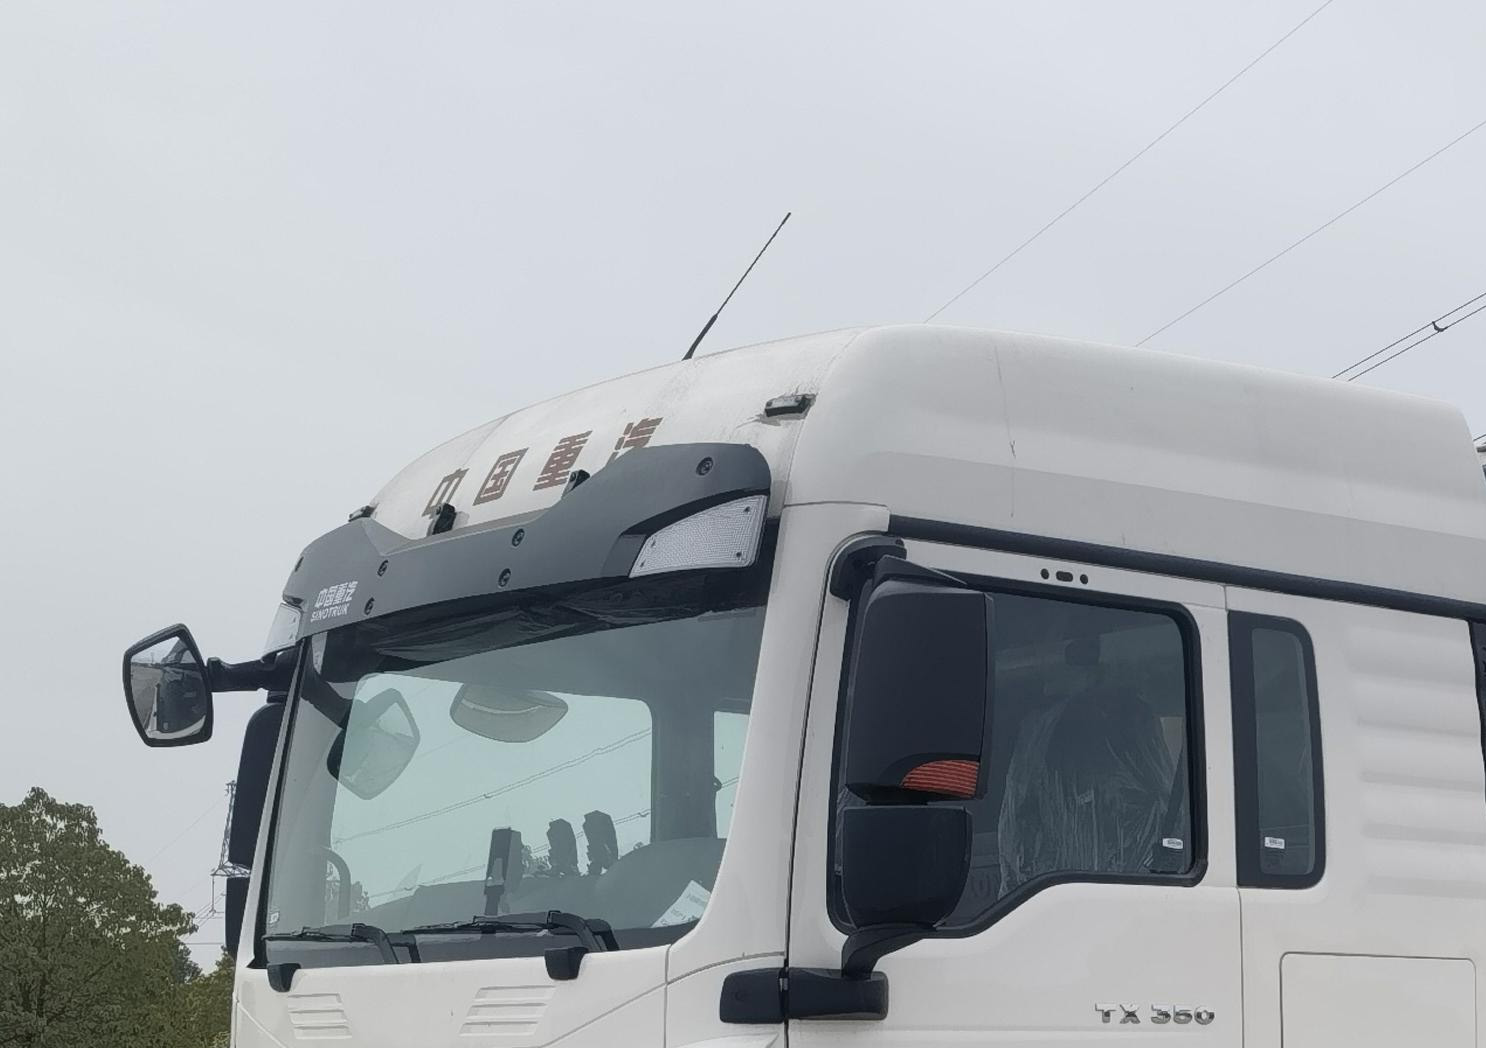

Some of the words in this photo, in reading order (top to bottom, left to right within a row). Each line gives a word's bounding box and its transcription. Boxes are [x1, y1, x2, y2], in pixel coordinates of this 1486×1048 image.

[314, 581, 358, 608] 中国重汽
[310, 602, 350, 622] SINOTRUK
[1095, 1003, 1141, 1024] TX
